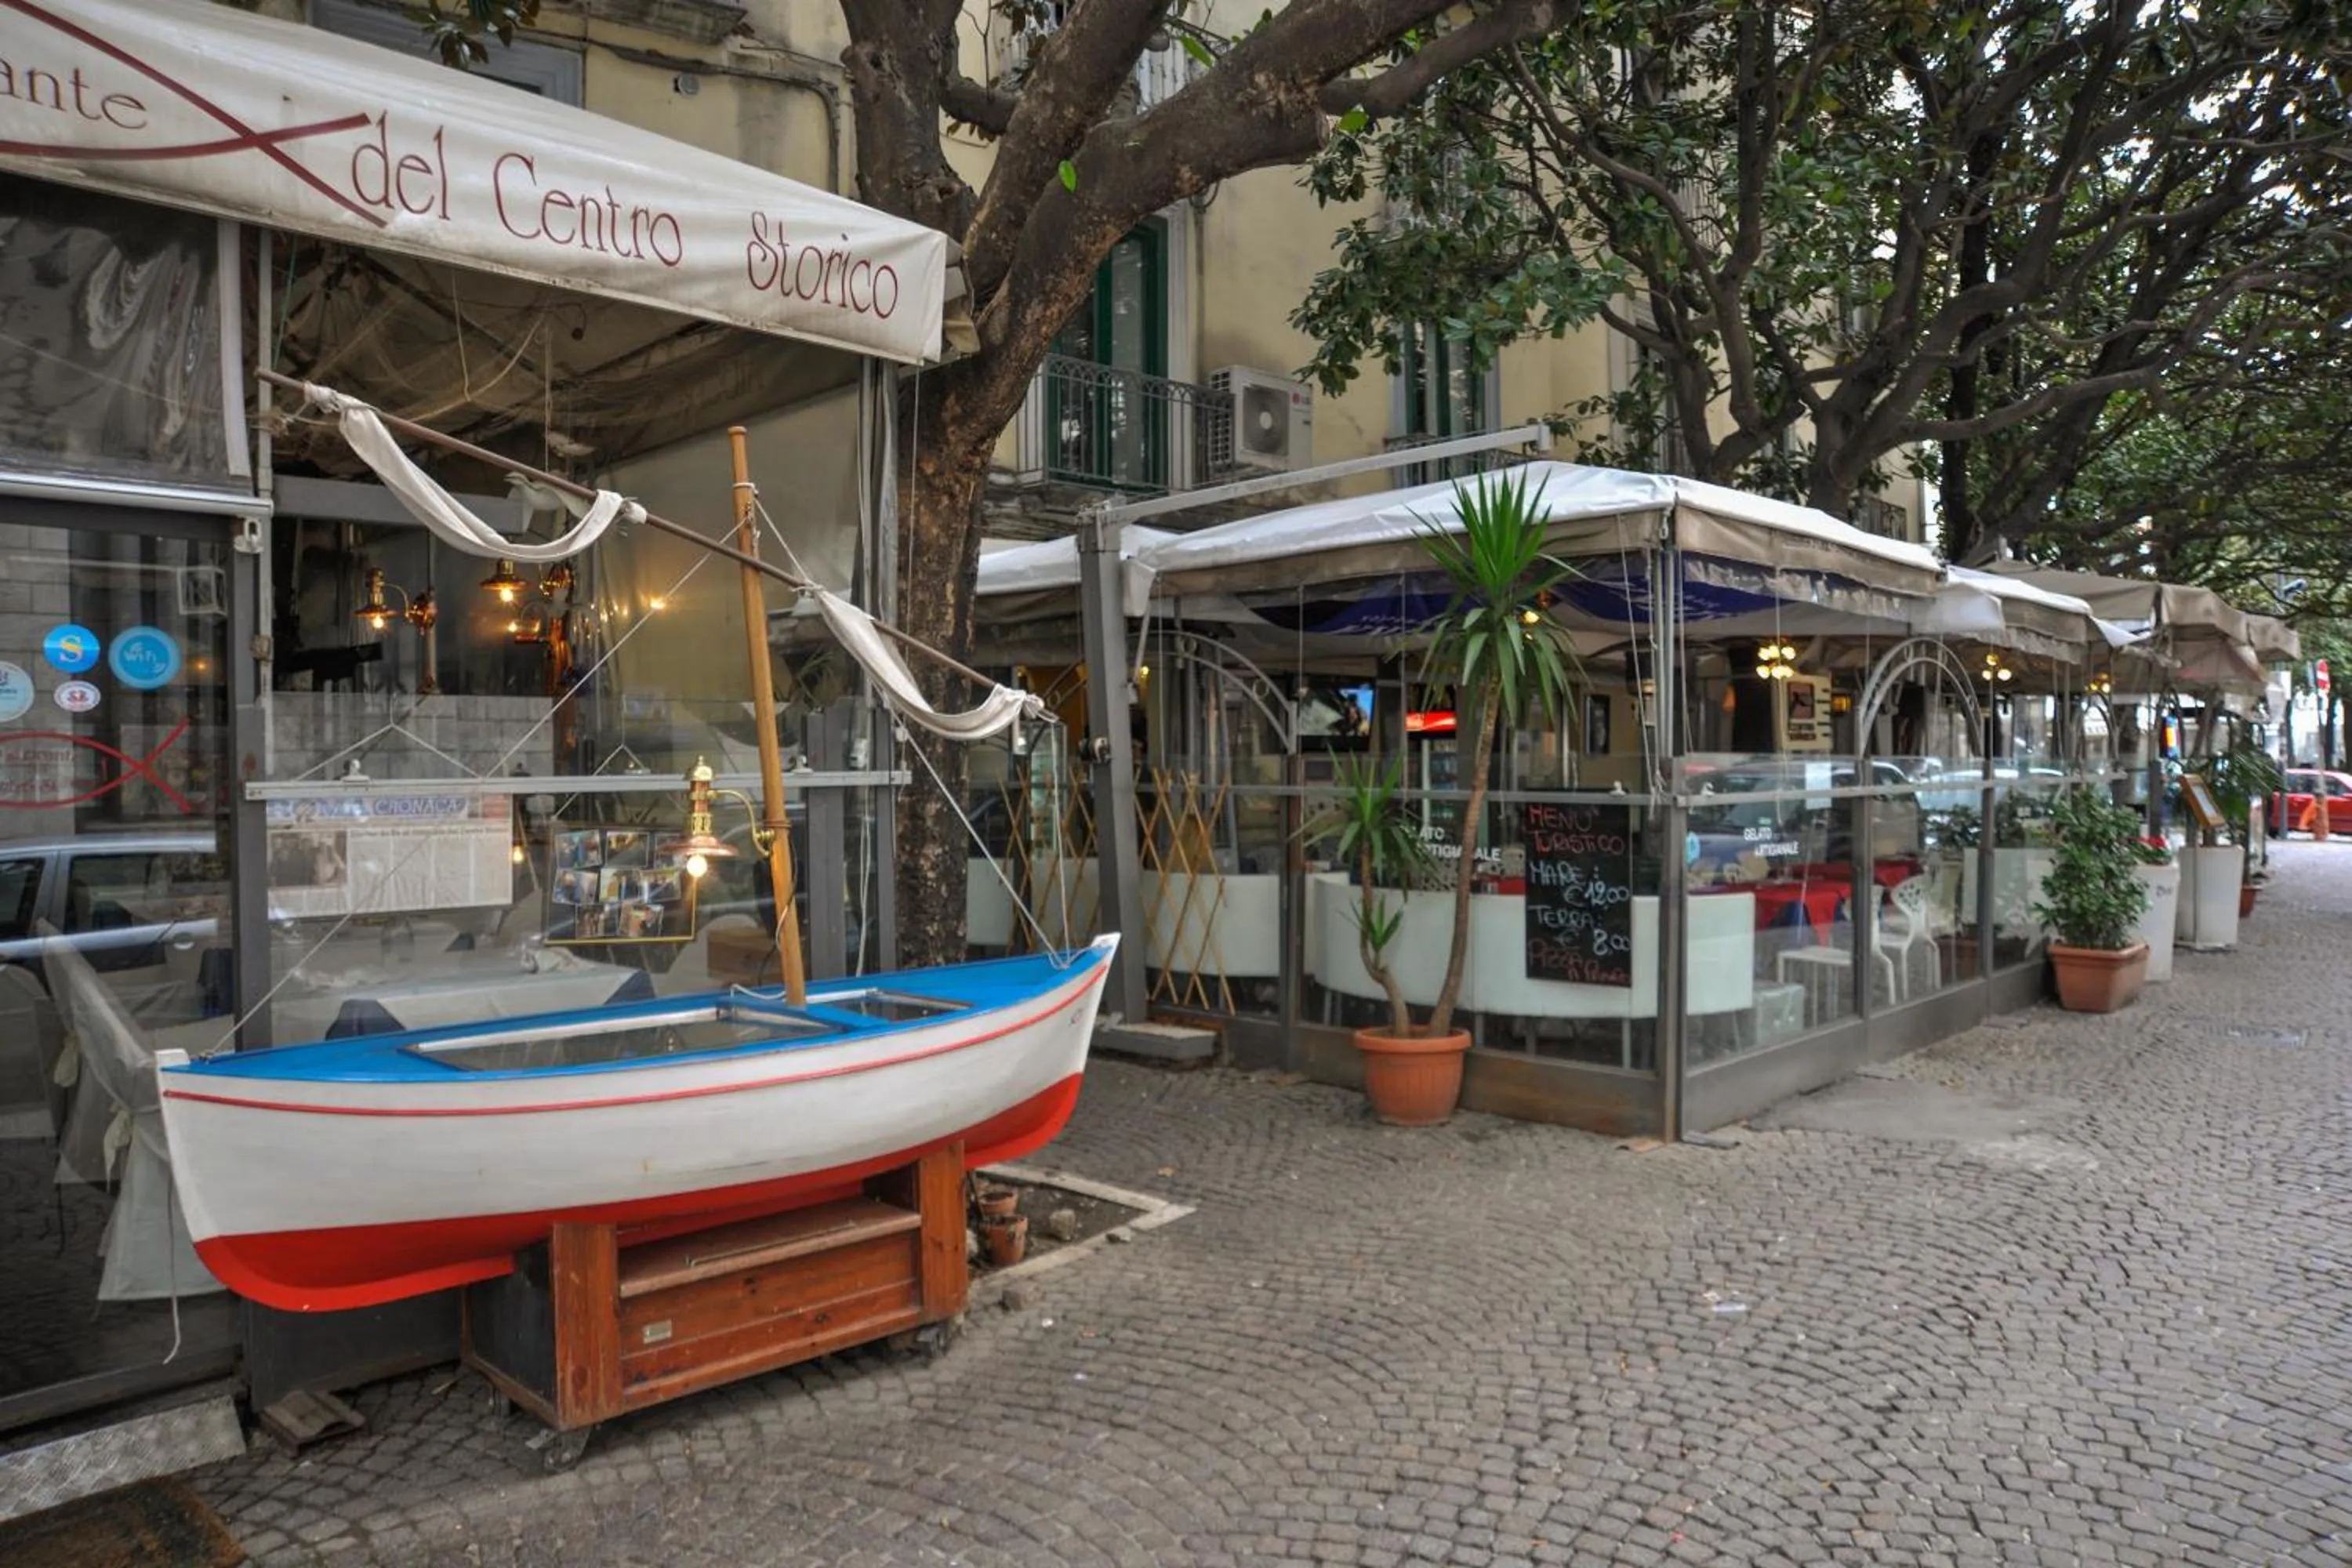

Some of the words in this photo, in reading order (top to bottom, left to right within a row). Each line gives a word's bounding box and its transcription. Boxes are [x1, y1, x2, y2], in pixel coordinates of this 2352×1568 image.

[351, 111, 451, 220] del
[492, 152, 684, 267] Centro
[746, 210, 899, 320] Storico
